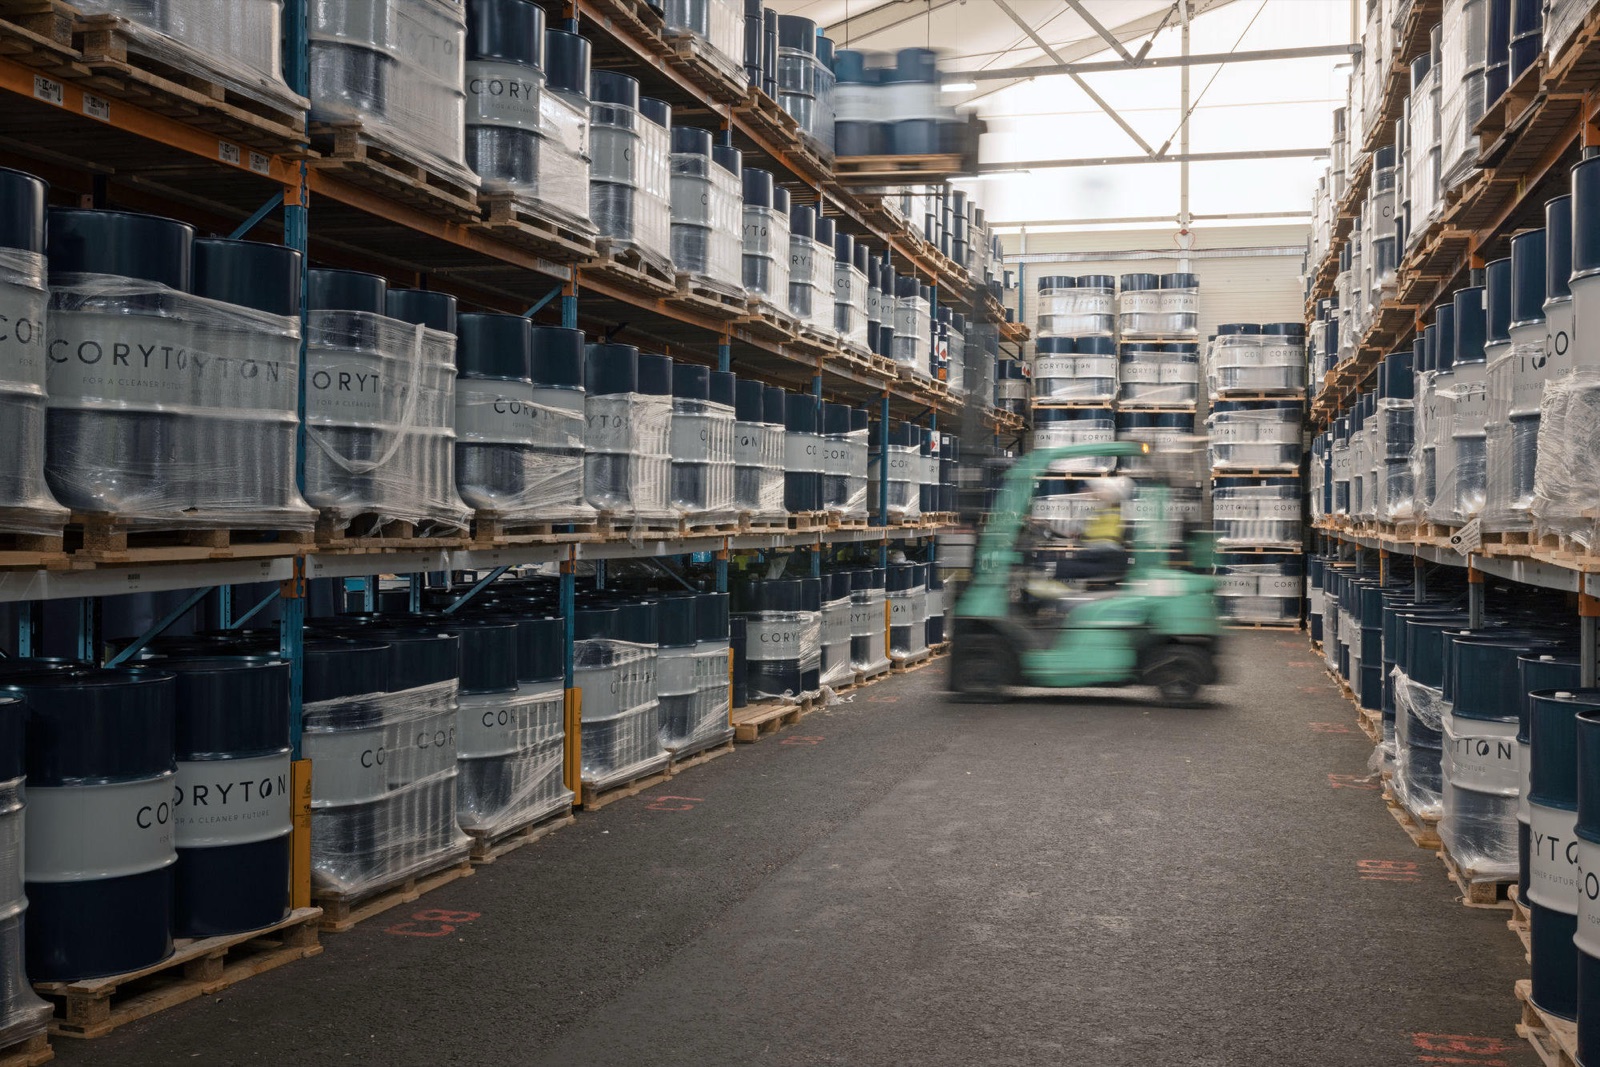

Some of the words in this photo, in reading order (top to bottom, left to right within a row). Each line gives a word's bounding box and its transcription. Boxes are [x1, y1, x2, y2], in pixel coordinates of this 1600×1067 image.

[136, 798, 175, 829] CO
[199, 814, 239, 825] CLEANER
[242, 809, 270, 820] FUTURE
